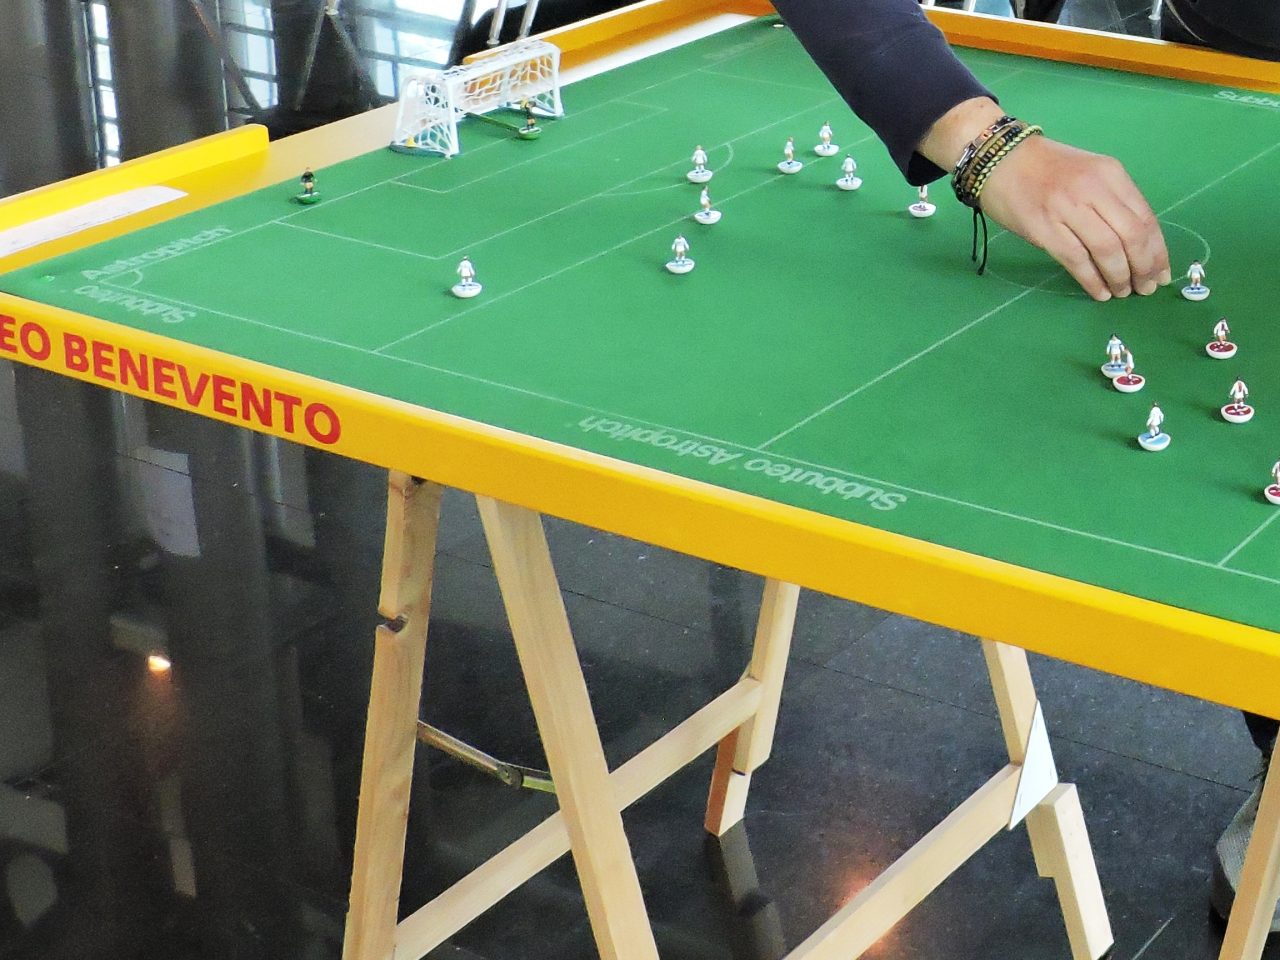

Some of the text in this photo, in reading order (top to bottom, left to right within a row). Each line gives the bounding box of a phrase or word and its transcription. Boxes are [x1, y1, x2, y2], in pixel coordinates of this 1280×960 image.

[80, 225, 233, 280] Astropitch
[73, 285, 197, 324] Subbuteo
[63, 332, 342, 445] BENEVENTO
[578, 415, 908, 511] Subbuteo Astropitch
